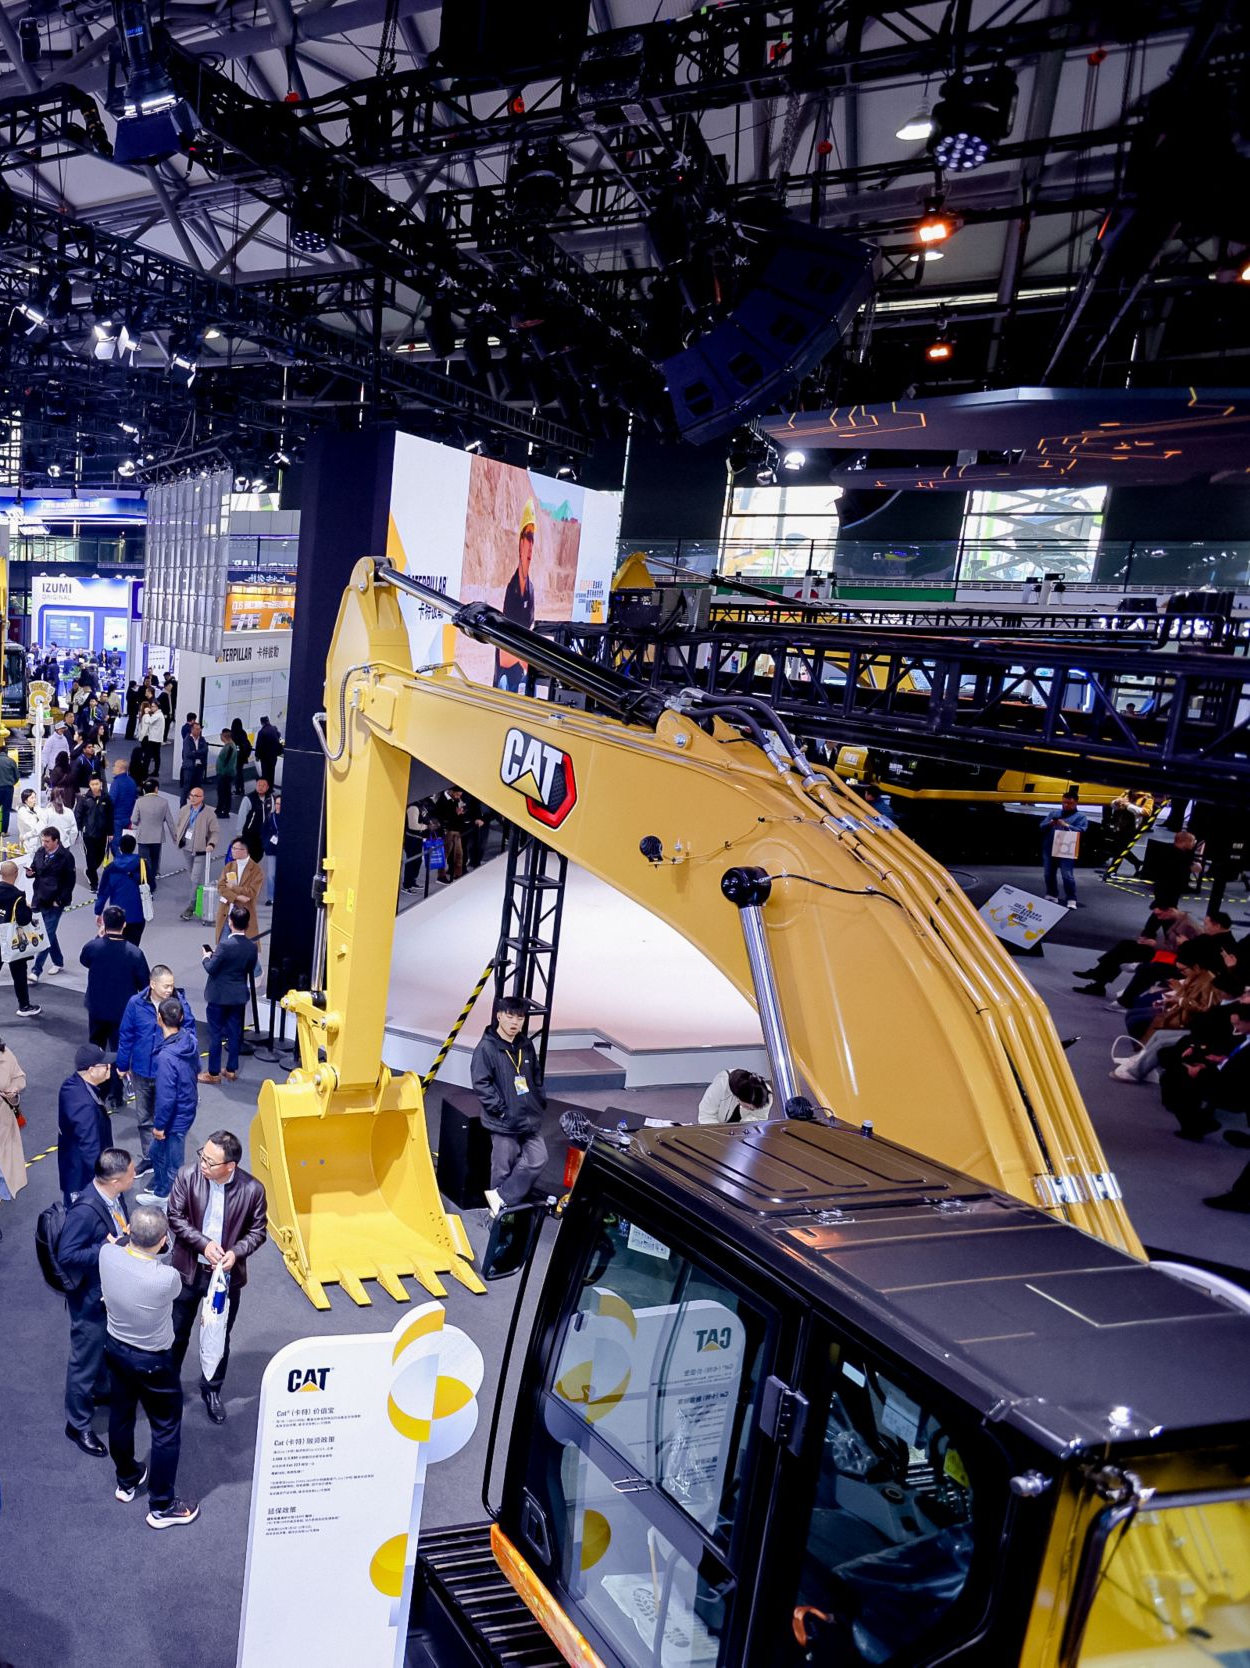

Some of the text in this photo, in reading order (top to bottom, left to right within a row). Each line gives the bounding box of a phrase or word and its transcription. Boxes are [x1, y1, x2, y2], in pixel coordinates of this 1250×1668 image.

[42, 582, 72, 593] IZUMI
[501, 728, 563, 805] CAT
[287, 1367, 331, 1393] CAT
